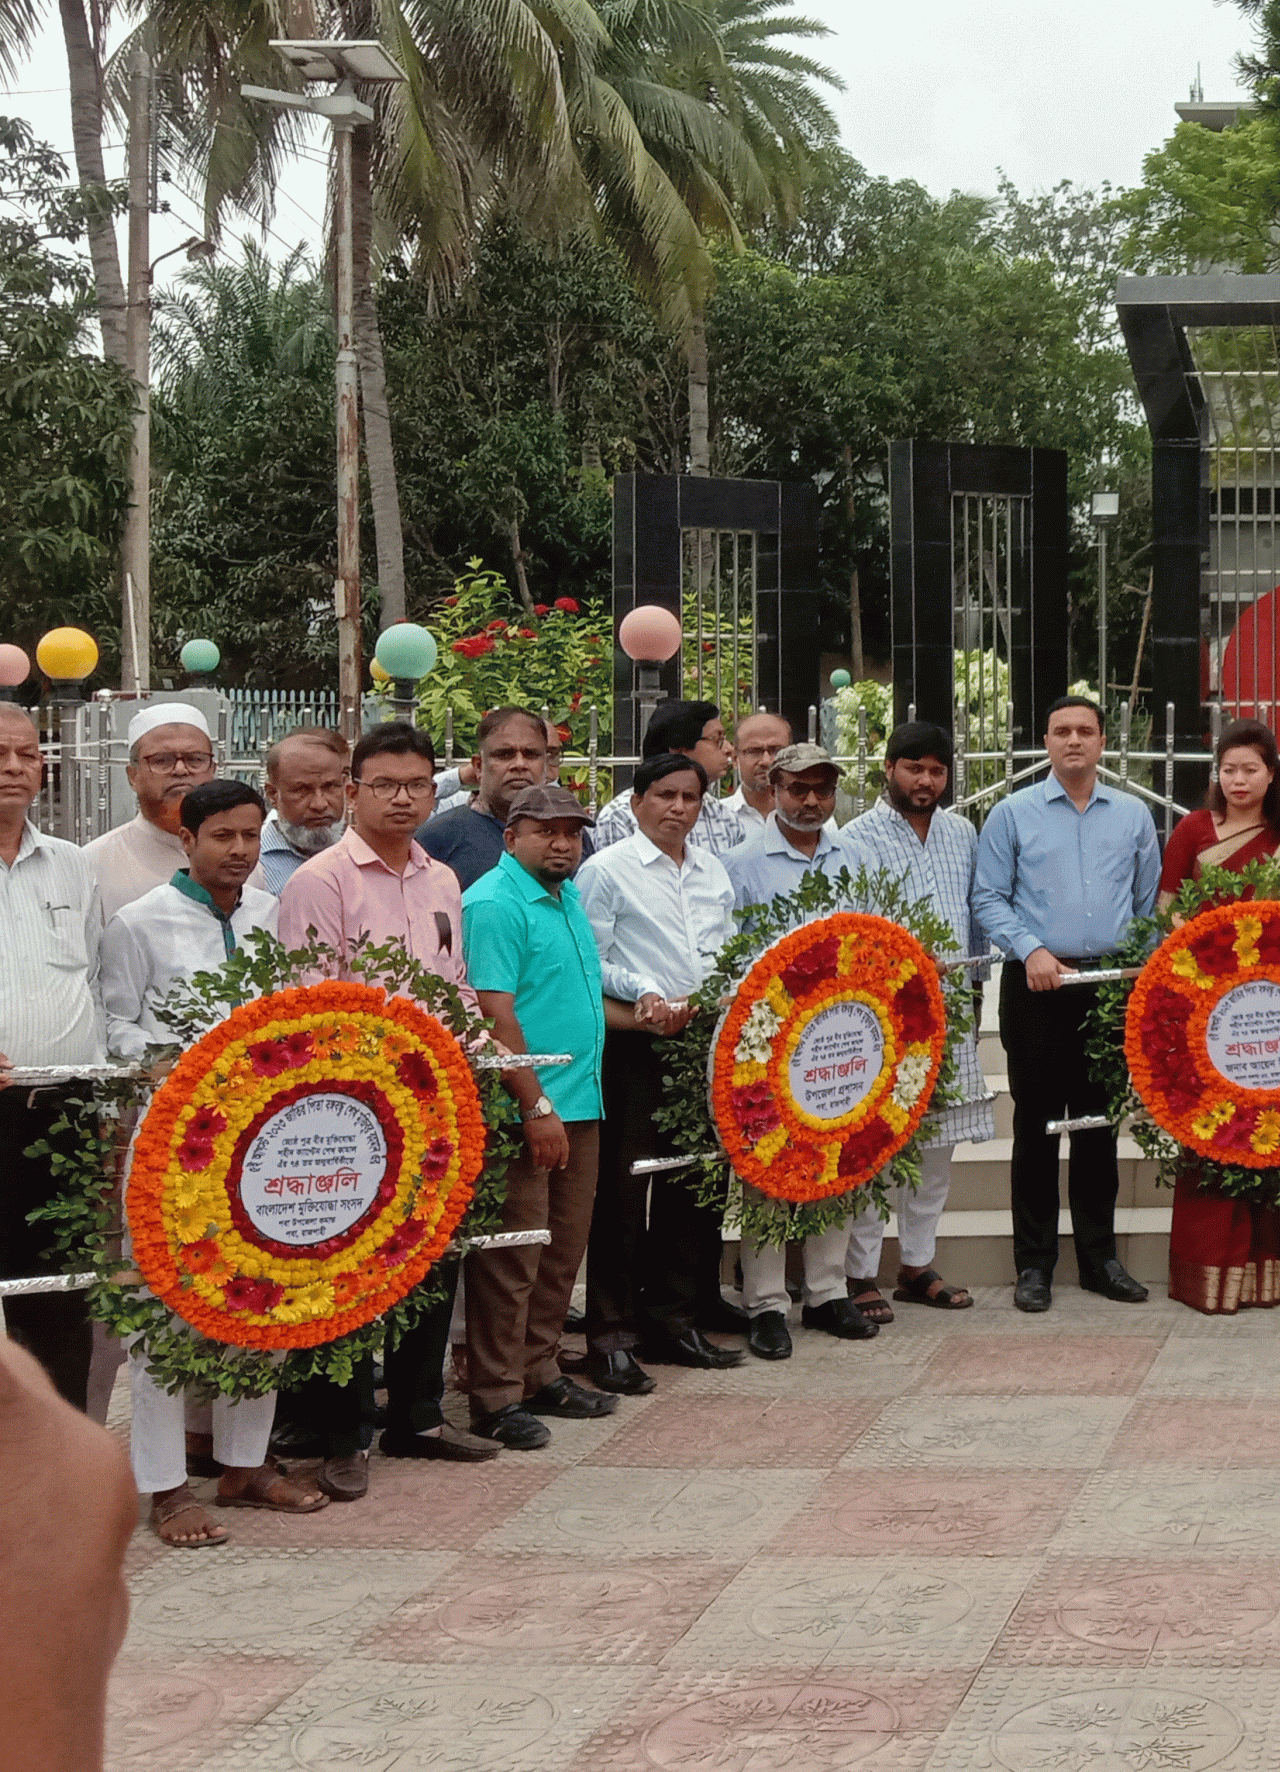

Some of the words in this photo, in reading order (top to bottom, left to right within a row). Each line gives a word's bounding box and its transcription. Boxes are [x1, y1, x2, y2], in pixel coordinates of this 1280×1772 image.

[804, 1056, 868, 1084] শ্রদ্ধাঞ্জলি
[1225, 1063, 1247, 1072] জনাব
[805, 1085, 836, 1101] উপজেলা
[839, 1081, 864, 1095] প্রশাসন
[266, 1118, 286, 1138] ২০২৩
[264, 1167, 362, 1196] শ্রদ্ধাঞ্জলি
[256, 1203, 296, 1216] বাংলাদেশ
[298, 1198, 338, 1216] মুক্তিযোদ্ধা
[340, 1198, 364, 1210] সংসদ
